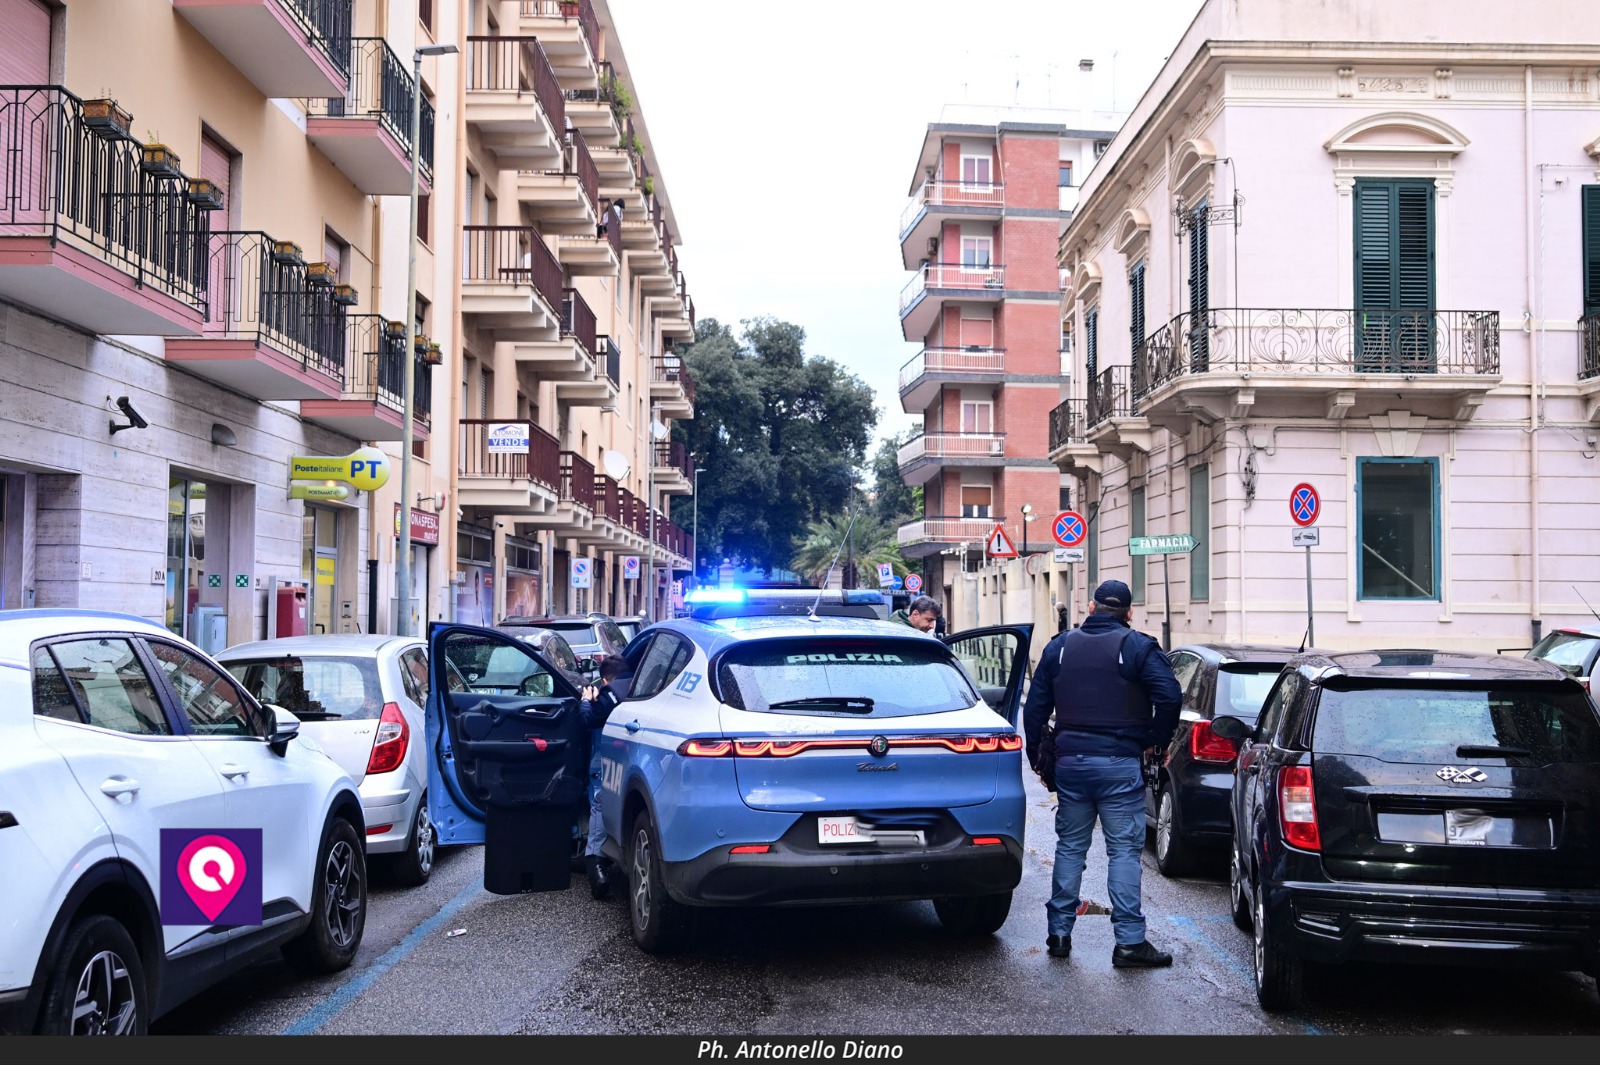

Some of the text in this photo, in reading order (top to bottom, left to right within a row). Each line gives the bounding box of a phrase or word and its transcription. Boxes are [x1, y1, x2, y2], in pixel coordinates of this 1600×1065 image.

[350, 460, 382, 479] PT
[411, 513, 436, 529] ONASPESA
[1141, 537, 1189, 549] FARMACIA
[787, 653, 903, 664] POLIZIA
[823, 823, 860, 837] POLIZ
